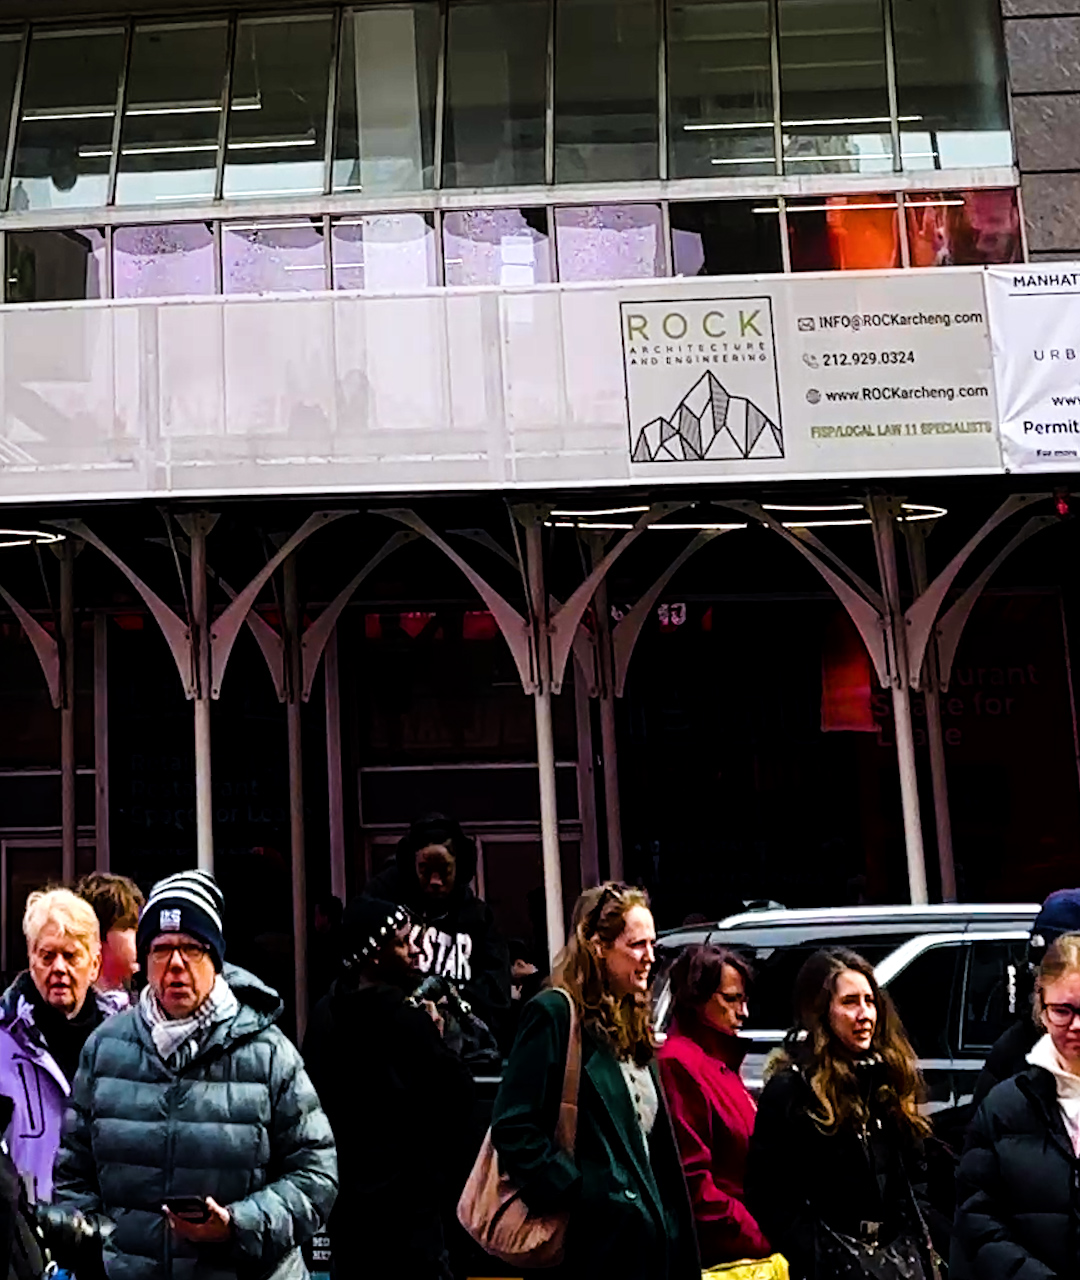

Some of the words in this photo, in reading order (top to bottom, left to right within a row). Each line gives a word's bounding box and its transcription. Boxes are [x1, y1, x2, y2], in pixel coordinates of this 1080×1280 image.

[1013, 273, 1080, 287] MANHAT
[626, 309, 763, 341] ROCK
[819, 312, 983, 333] INFO@ROCKarcheng.com
[629, 341, 766, 355] ARCHITECTURE
[631, 357, 658, 365] AND
[666, 353, 767, 365] ENGINEERING
[822, 351, 915, 366] 212.929.0324
[825, 386, 989, 402] www.ROCKarcheng.com
[877, 423, 902, 436] LAW
